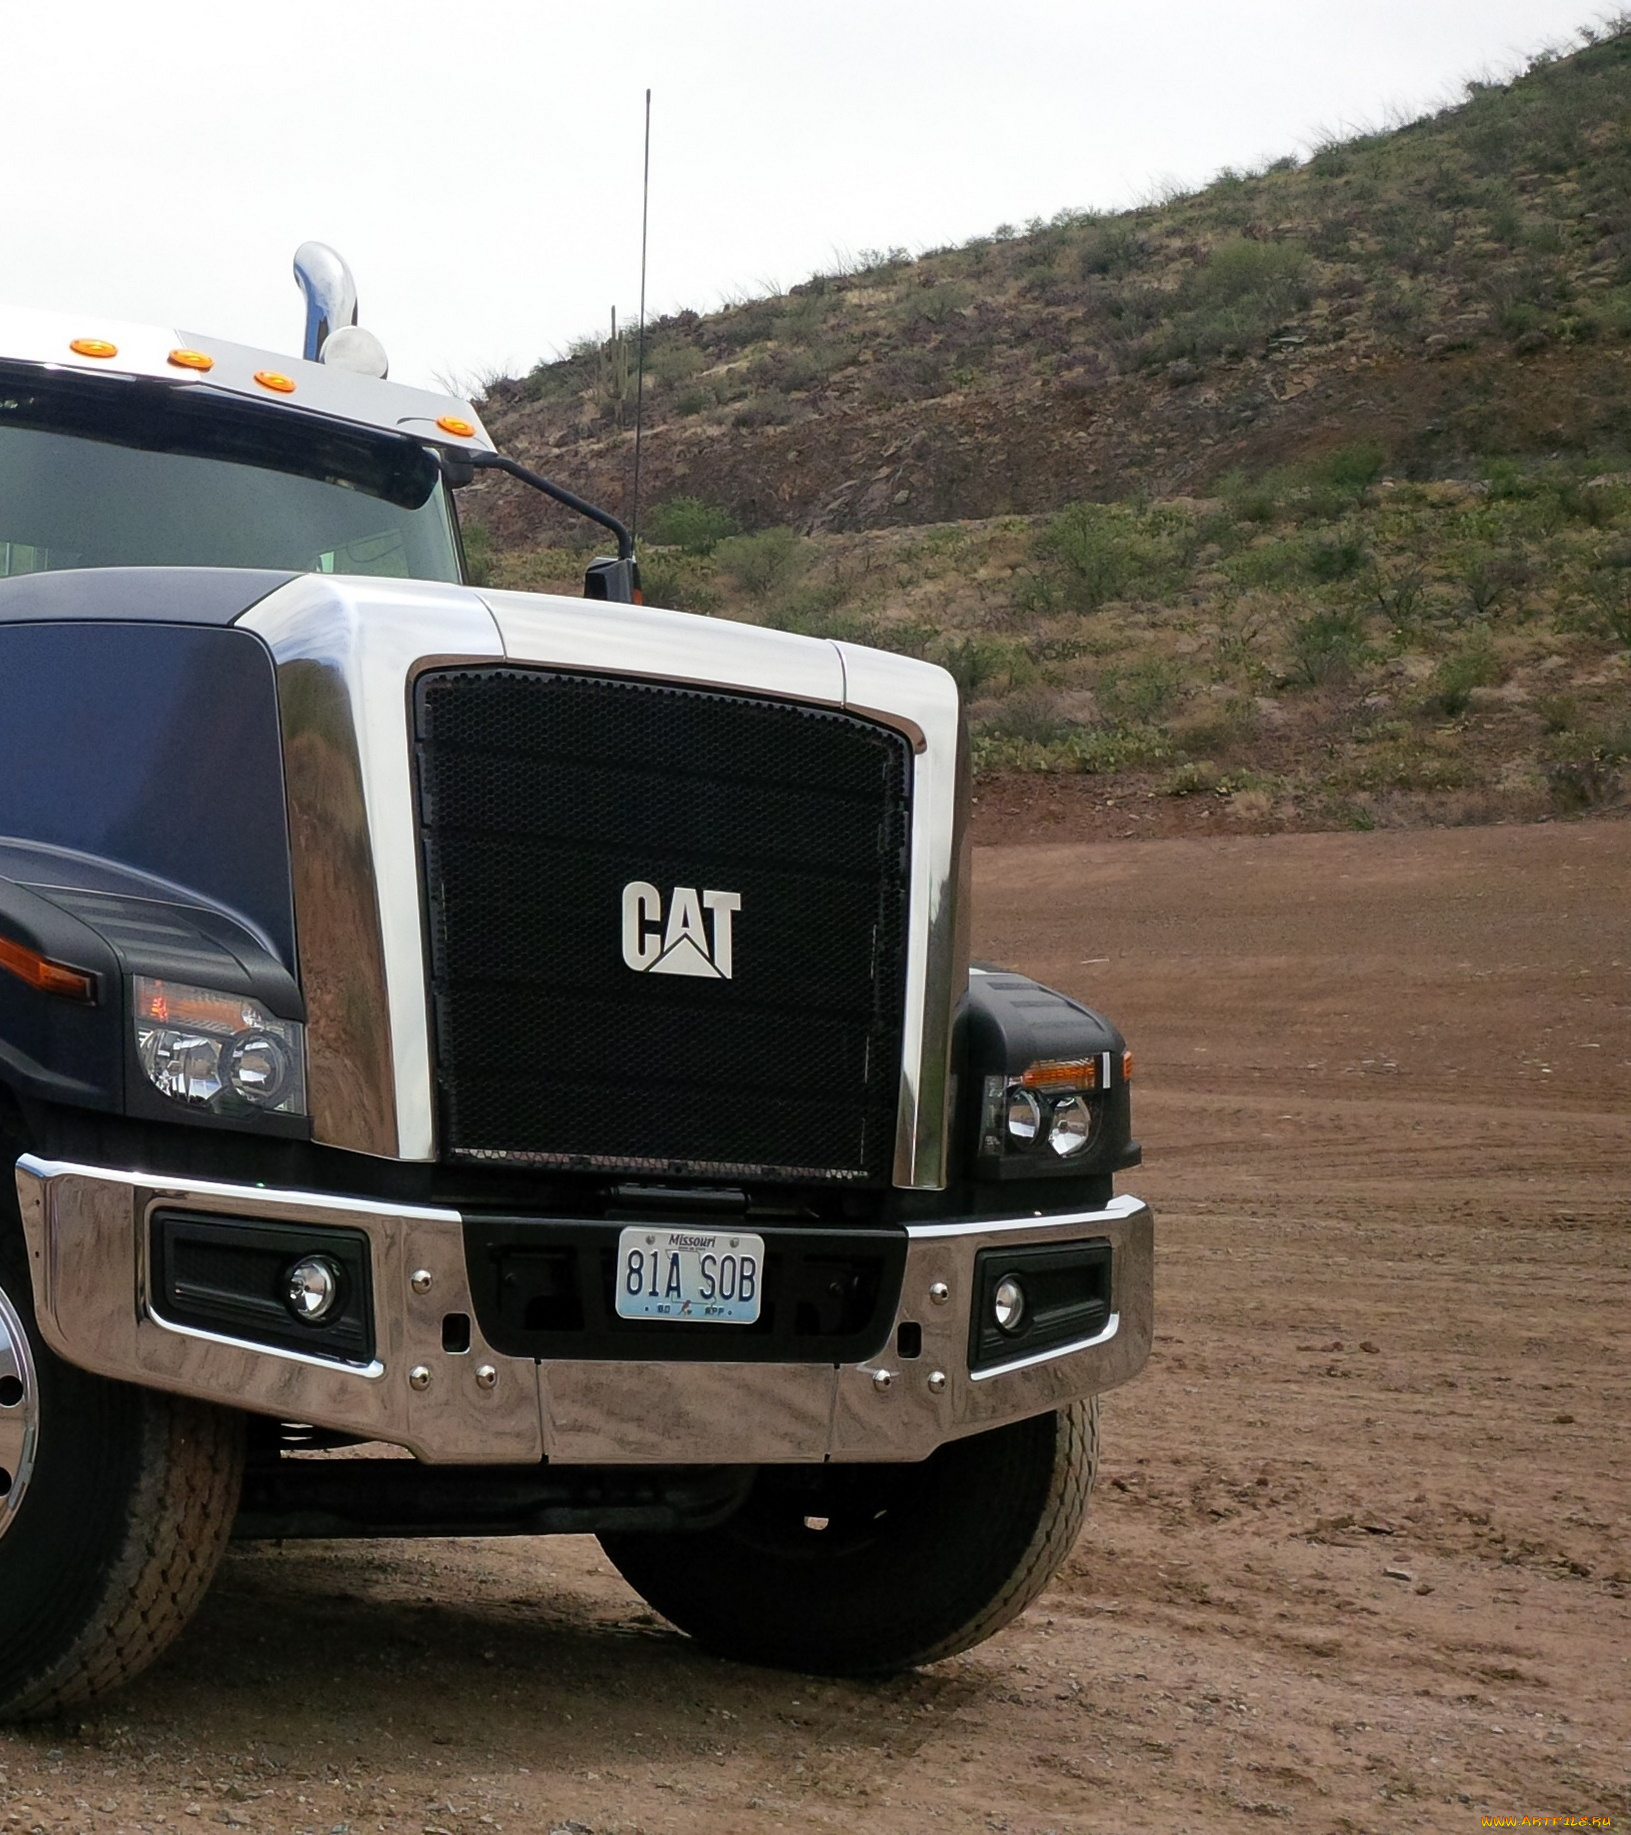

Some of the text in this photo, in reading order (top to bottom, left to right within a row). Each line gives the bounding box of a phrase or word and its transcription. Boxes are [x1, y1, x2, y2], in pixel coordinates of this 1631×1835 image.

[622, 880, 741, 980] CAT
[668, 1233, 716, 1248] Missouri
[626, 1249, 681, 1299] 81A
